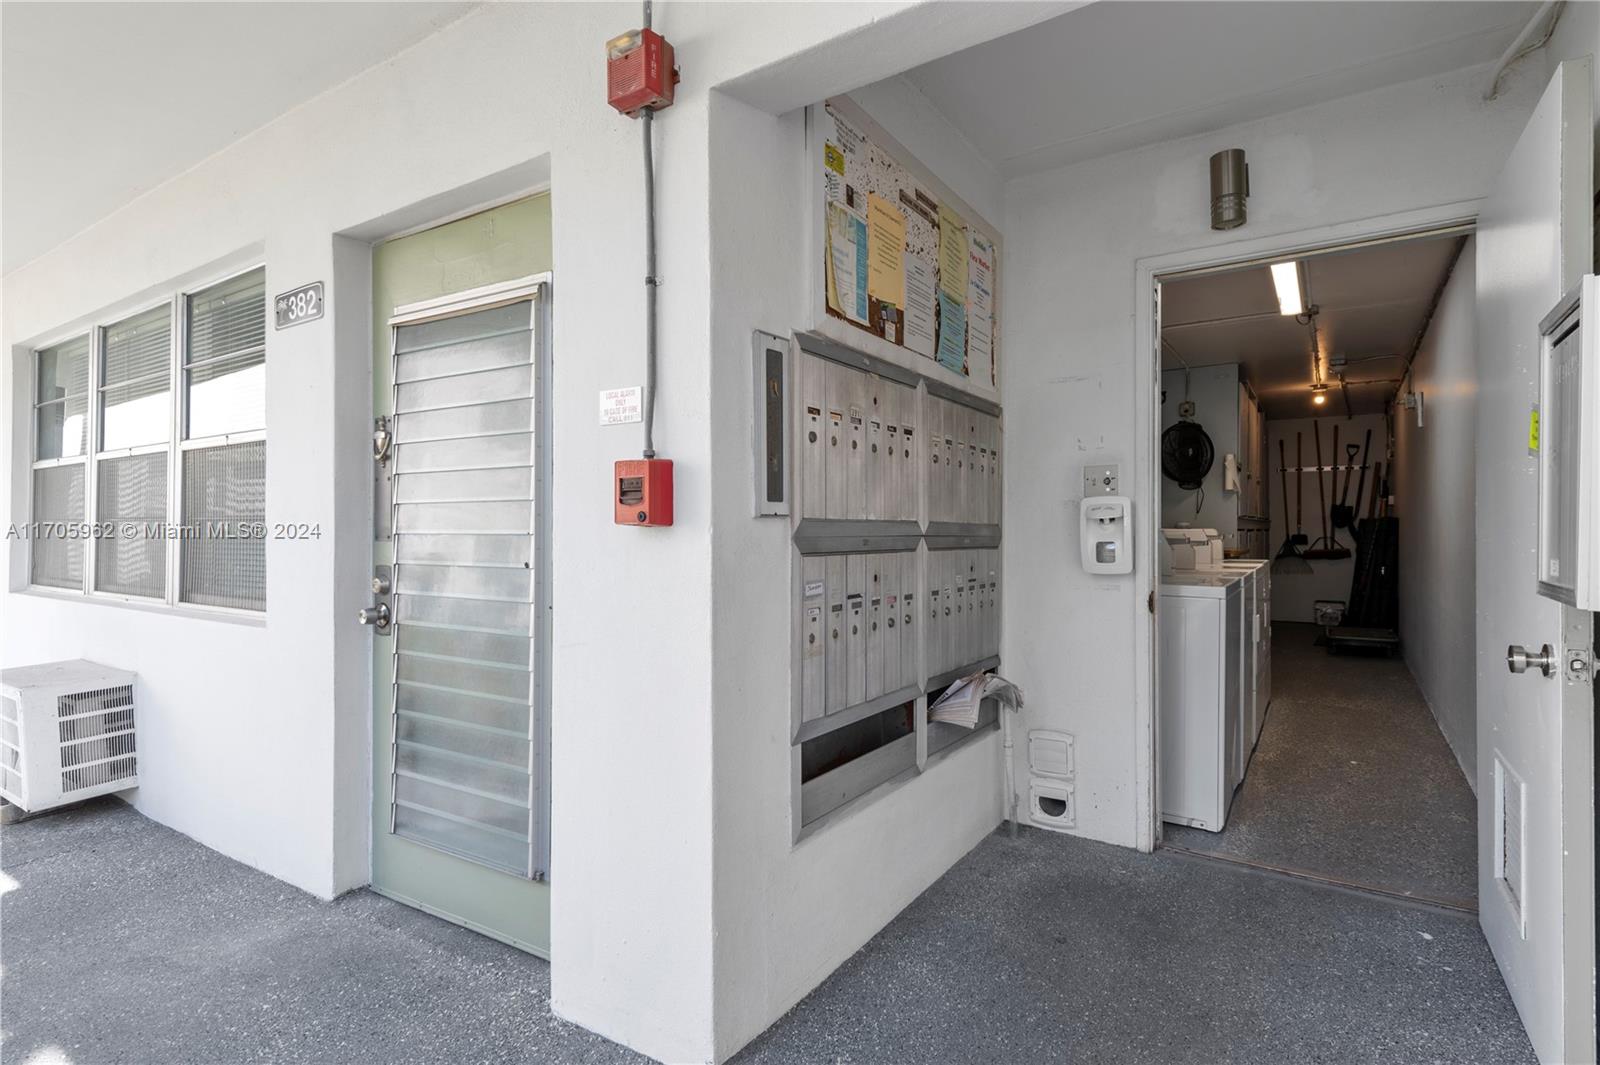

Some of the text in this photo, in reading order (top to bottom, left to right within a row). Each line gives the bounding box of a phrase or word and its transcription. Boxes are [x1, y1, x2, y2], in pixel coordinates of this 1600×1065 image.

[288, 290, 317, 320] 382
[606, 391, 619, 400] LOCAL
[608, 415, 623, 423] CALL
